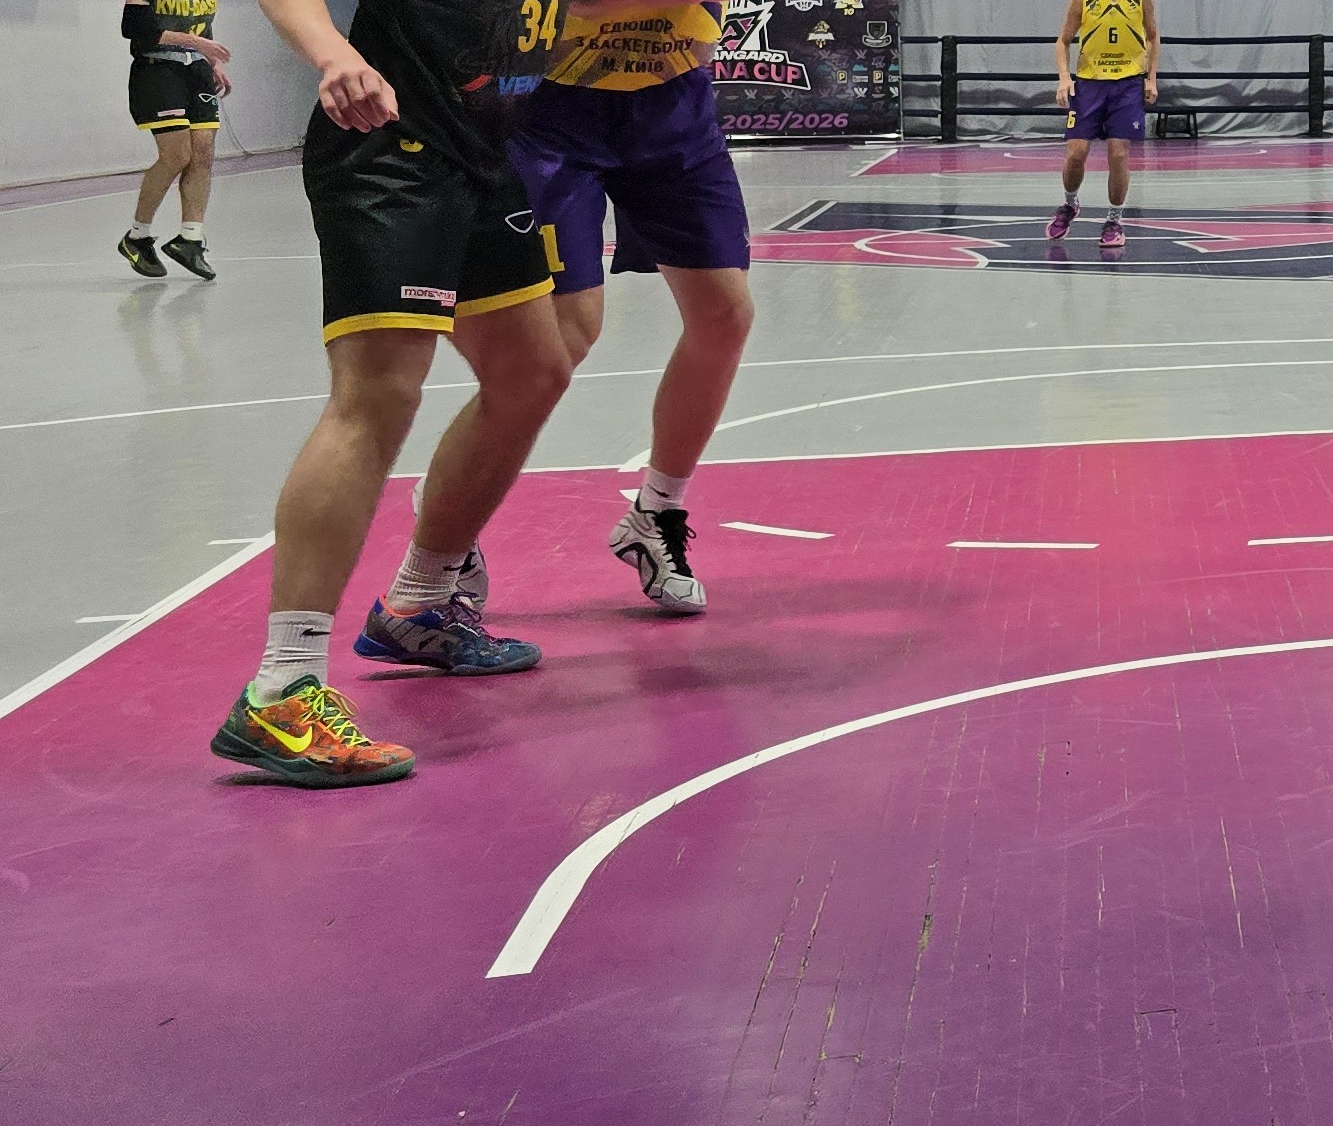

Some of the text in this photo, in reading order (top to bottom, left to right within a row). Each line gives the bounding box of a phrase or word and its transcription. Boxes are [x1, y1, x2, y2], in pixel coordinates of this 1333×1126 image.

[1108, 27, 1118, 44] 6
[589, 37, 694, 55] БАСКЕТБОЛУ
[753, 62, 801, 84] CUP
[722, 111, 849, 131] 2025/2026
[1067, 111, 1076, 129] 6
